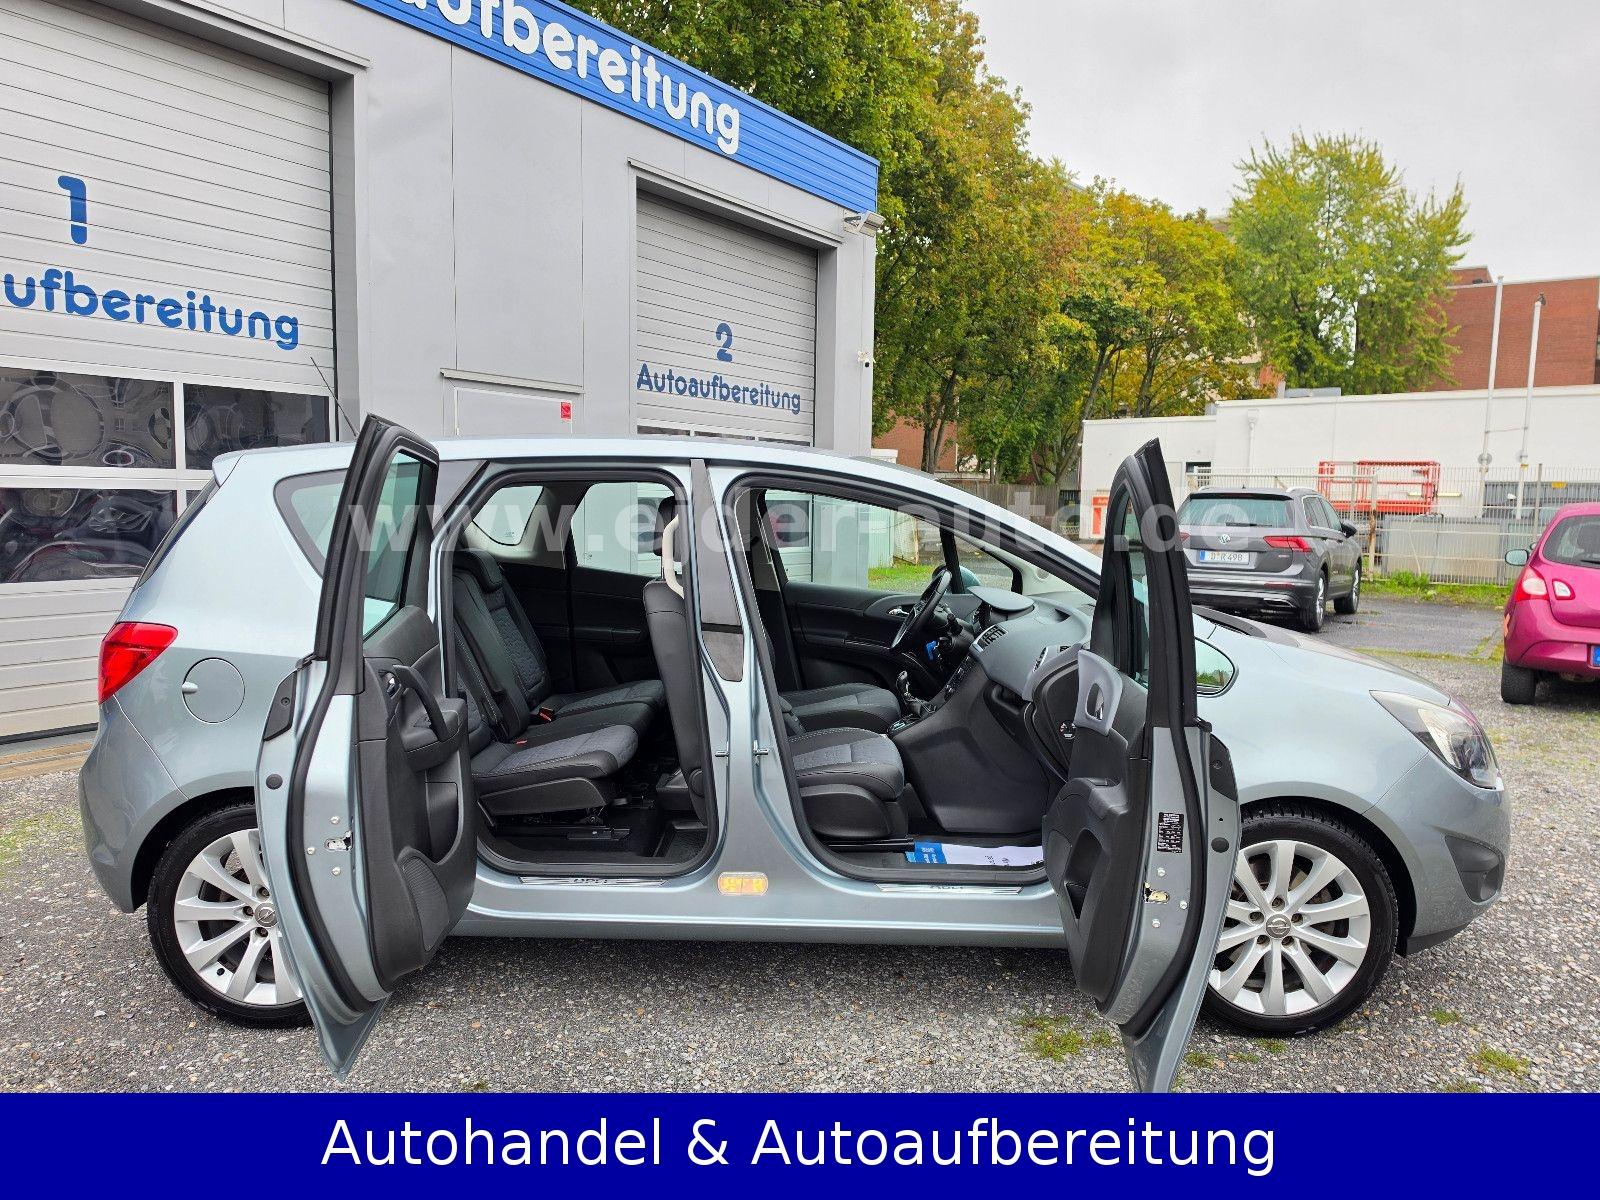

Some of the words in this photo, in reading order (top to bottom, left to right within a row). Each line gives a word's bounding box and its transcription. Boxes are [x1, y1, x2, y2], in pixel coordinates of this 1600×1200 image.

[404, 0, 740, 155] ufbereitung
[57, 175, 88, 245] 1
[4, 268, 299, 351] ufbereitung
[715, 322, 733, 363] 2
[636, 362, 801, 415] Autoaufbereitung
